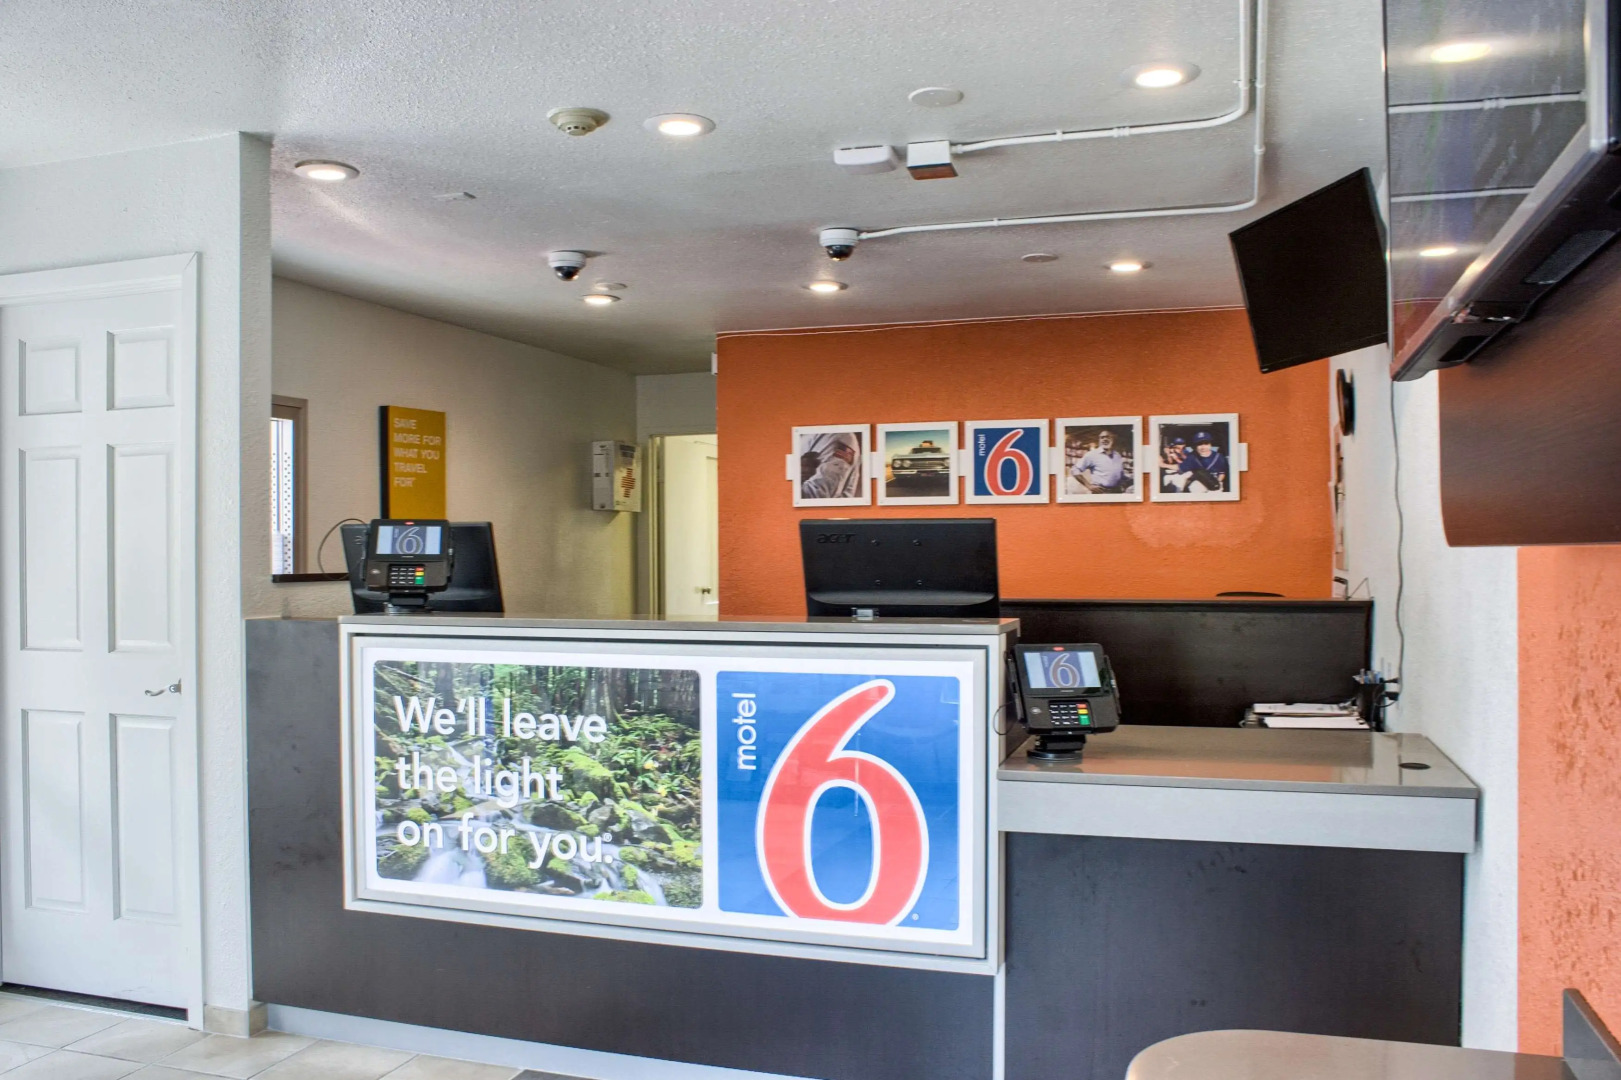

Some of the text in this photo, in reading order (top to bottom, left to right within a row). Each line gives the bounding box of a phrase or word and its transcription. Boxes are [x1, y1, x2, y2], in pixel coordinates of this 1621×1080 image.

[393, 417, 417, 430] SAVE
[393, 433, 442, 446] MORE FOR
[393, 448, 441, 460] WHAT YOU
[393, 462, 428, 474] TRAVEL
[978, 428, 1034, 497] motel 6
[395, 526, 424, 555] 6
[816, 533, 856, 544] acer
[1049, 652, 1080, 688] 6
[503, 698, 607, 743] leave
[395, 751, 564, 808] the light
[731, 678, 930, 927] motel 6
[397, 819, 443, 848] on
[458, 812, 516, 854] for
